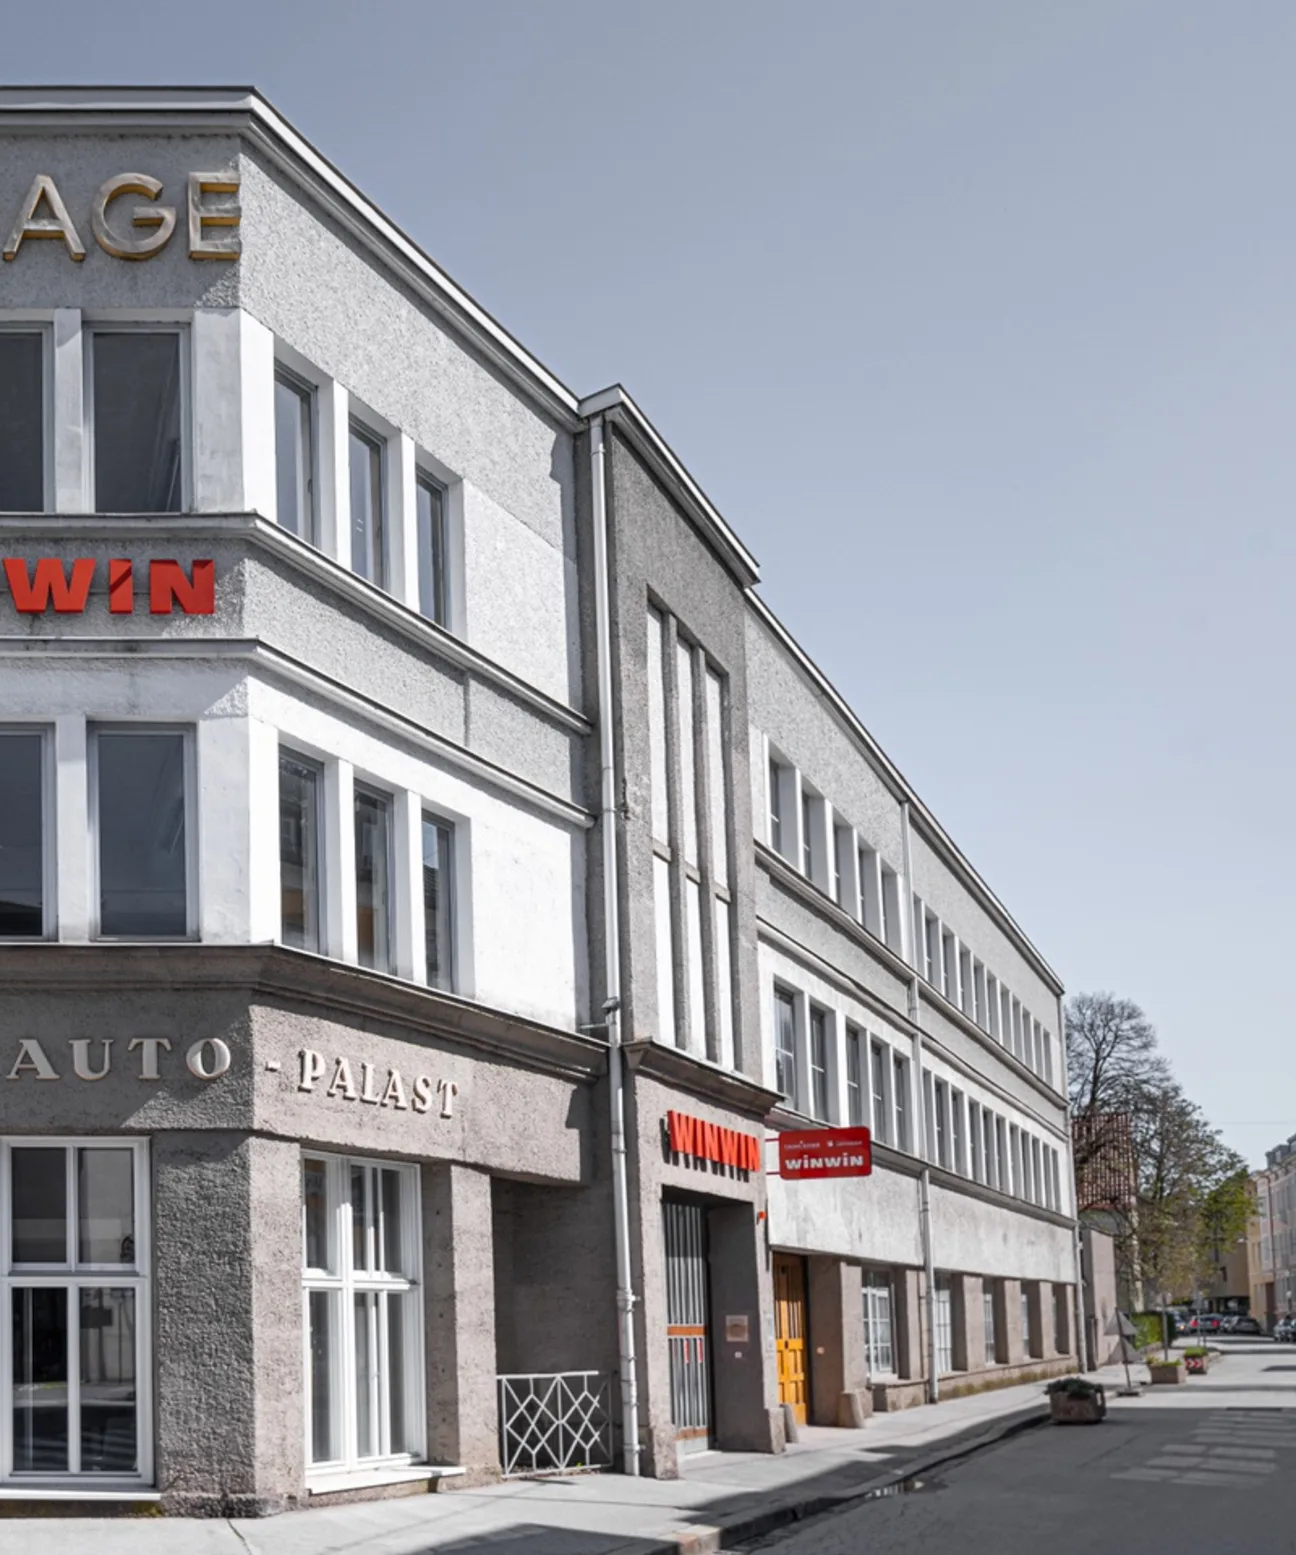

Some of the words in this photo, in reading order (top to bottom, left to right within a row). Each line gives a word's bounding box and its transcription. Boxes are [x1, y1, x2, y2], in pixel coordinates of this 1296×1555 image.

[5, 1037, 232, 1081] AUTO
[297, 1048, 459, 1119] PALAST
[666, 1109, 761, 1173] WINWIN
